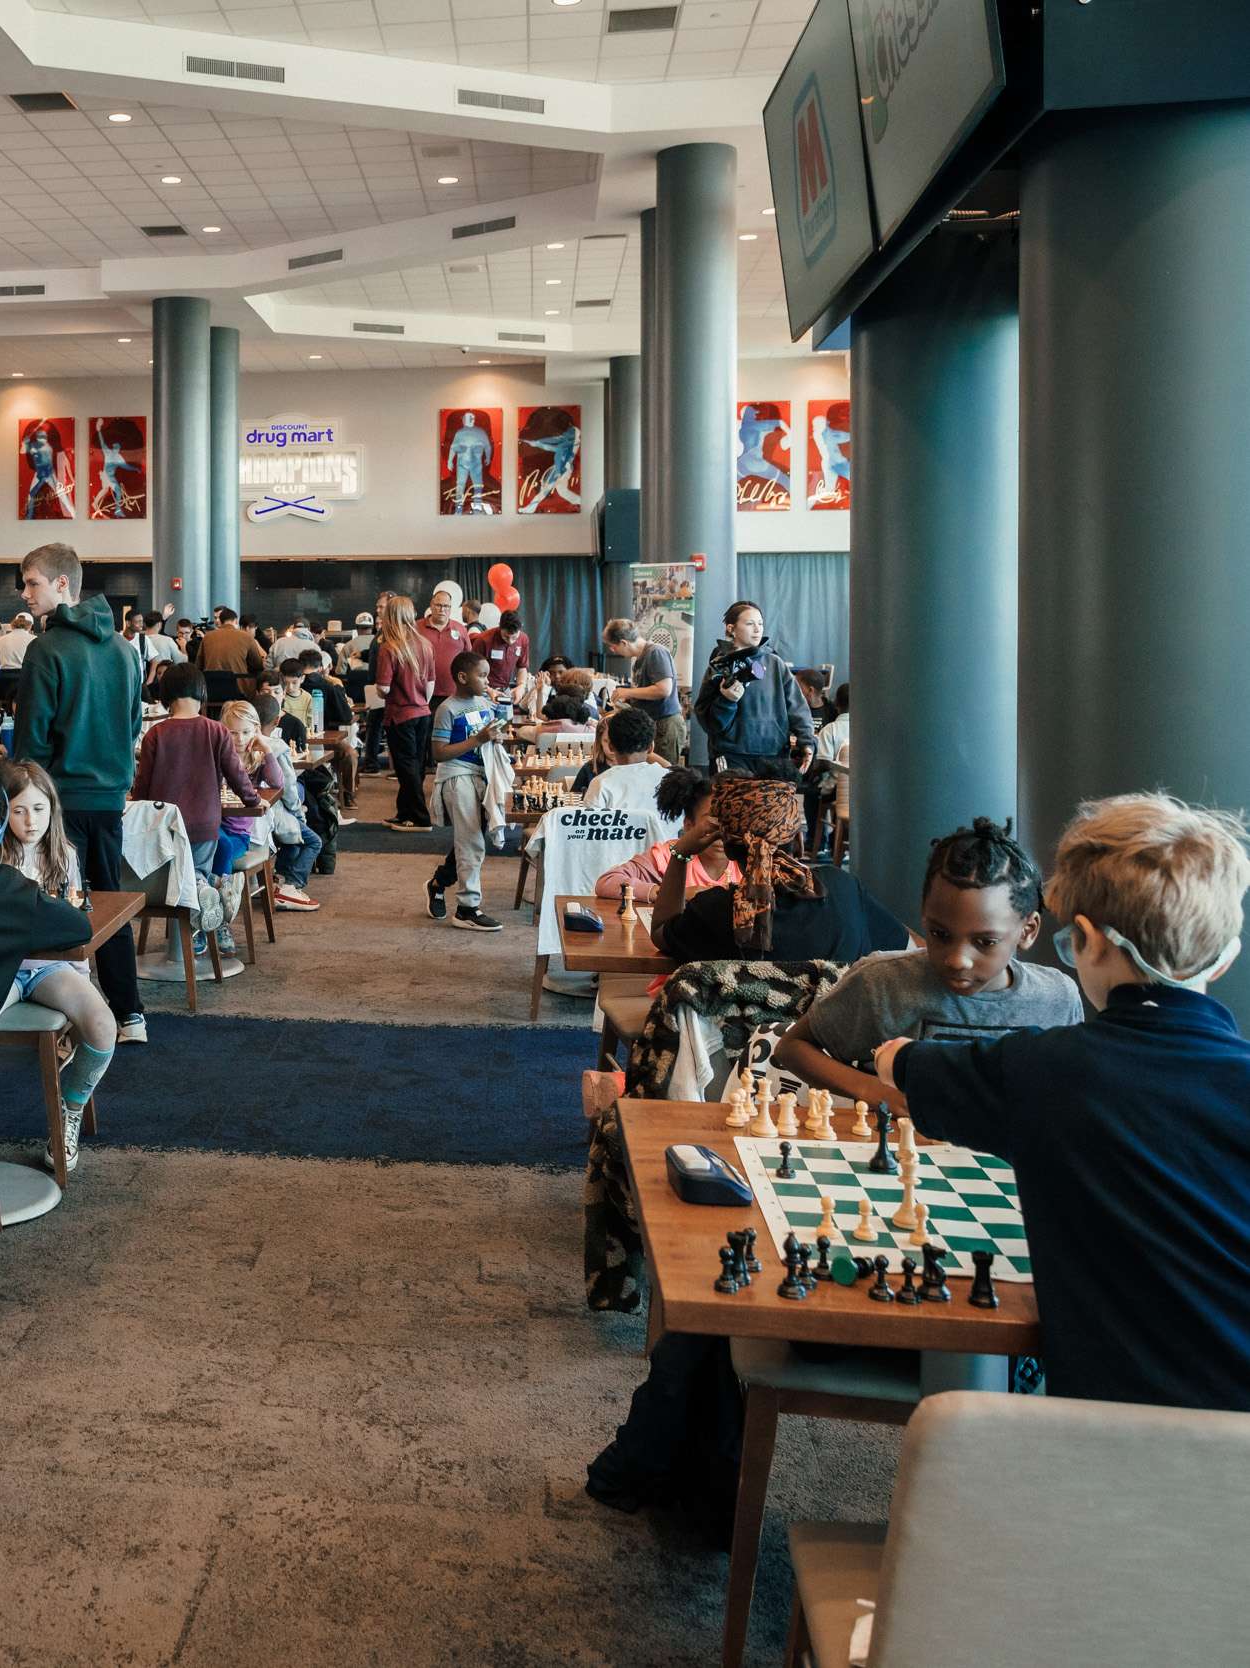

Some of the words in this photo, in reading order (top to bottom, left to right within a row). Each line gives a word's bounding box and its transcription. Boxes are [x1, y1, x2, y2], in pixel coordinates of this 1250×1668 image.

[246, 429, 287, 448] drug
[290, 428, 334, 442] mart
[239, 454, 358, 494] HAMPIONS
[273, 485, 307, 494] CLUB
[560, 809, 628, 826] check
[586, 825, 647, 841] mate
